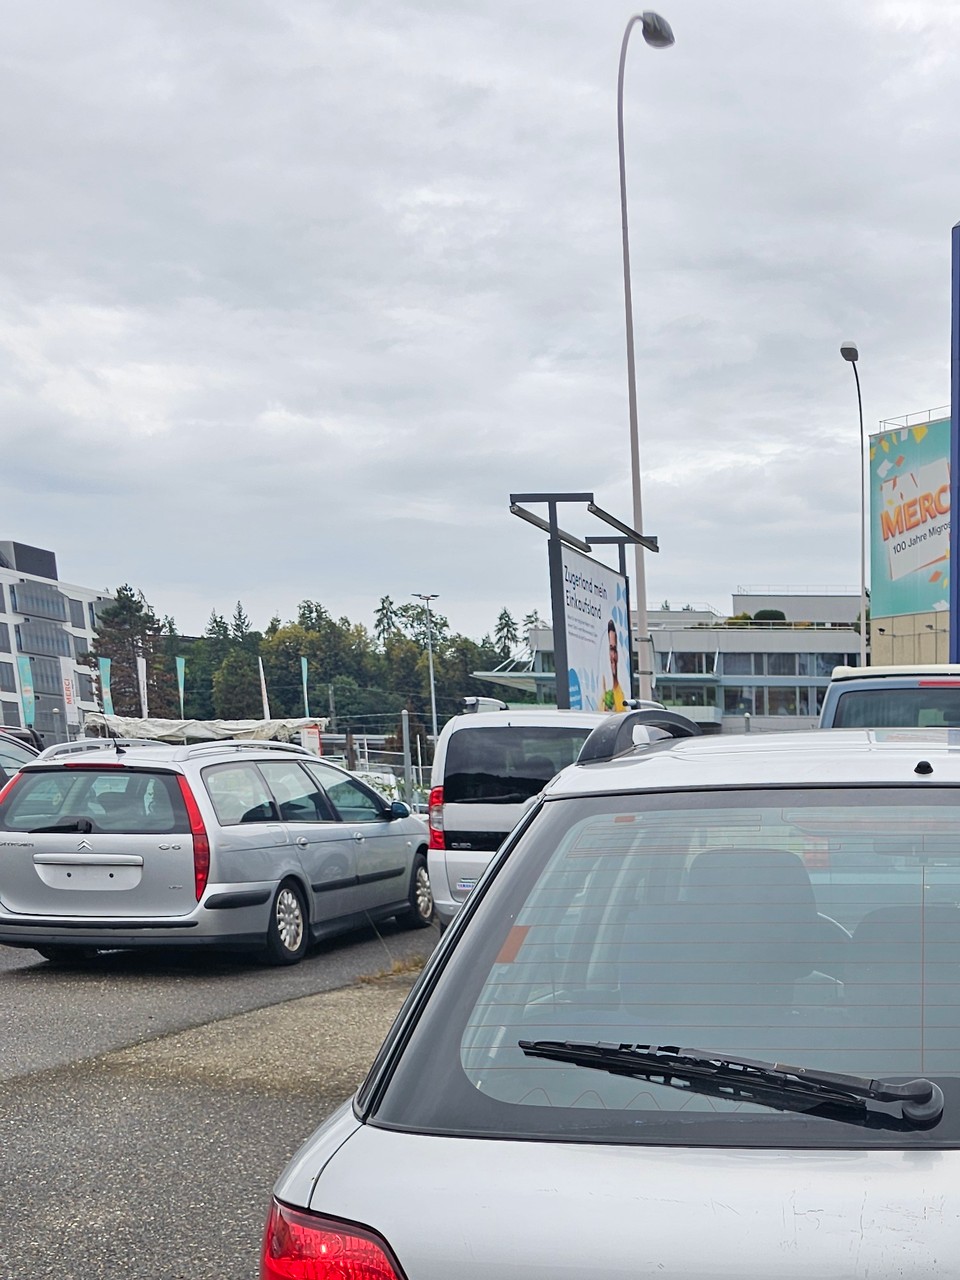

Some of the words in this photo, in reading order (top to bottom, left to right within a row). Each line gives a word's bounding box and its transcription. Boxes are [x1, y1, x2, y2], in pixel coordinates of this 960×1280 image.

[881, 484, 951, 541] MERC
[893, 541, 907, 554] 100
[908, 533, 928, 548] Jahre
[564, 565, 593, 593] Zugerland
[594, 582, 607, 600] mein
[566, 589, 602, 619] Einkaufsland
[64, 678, 72, 705] MERCI
